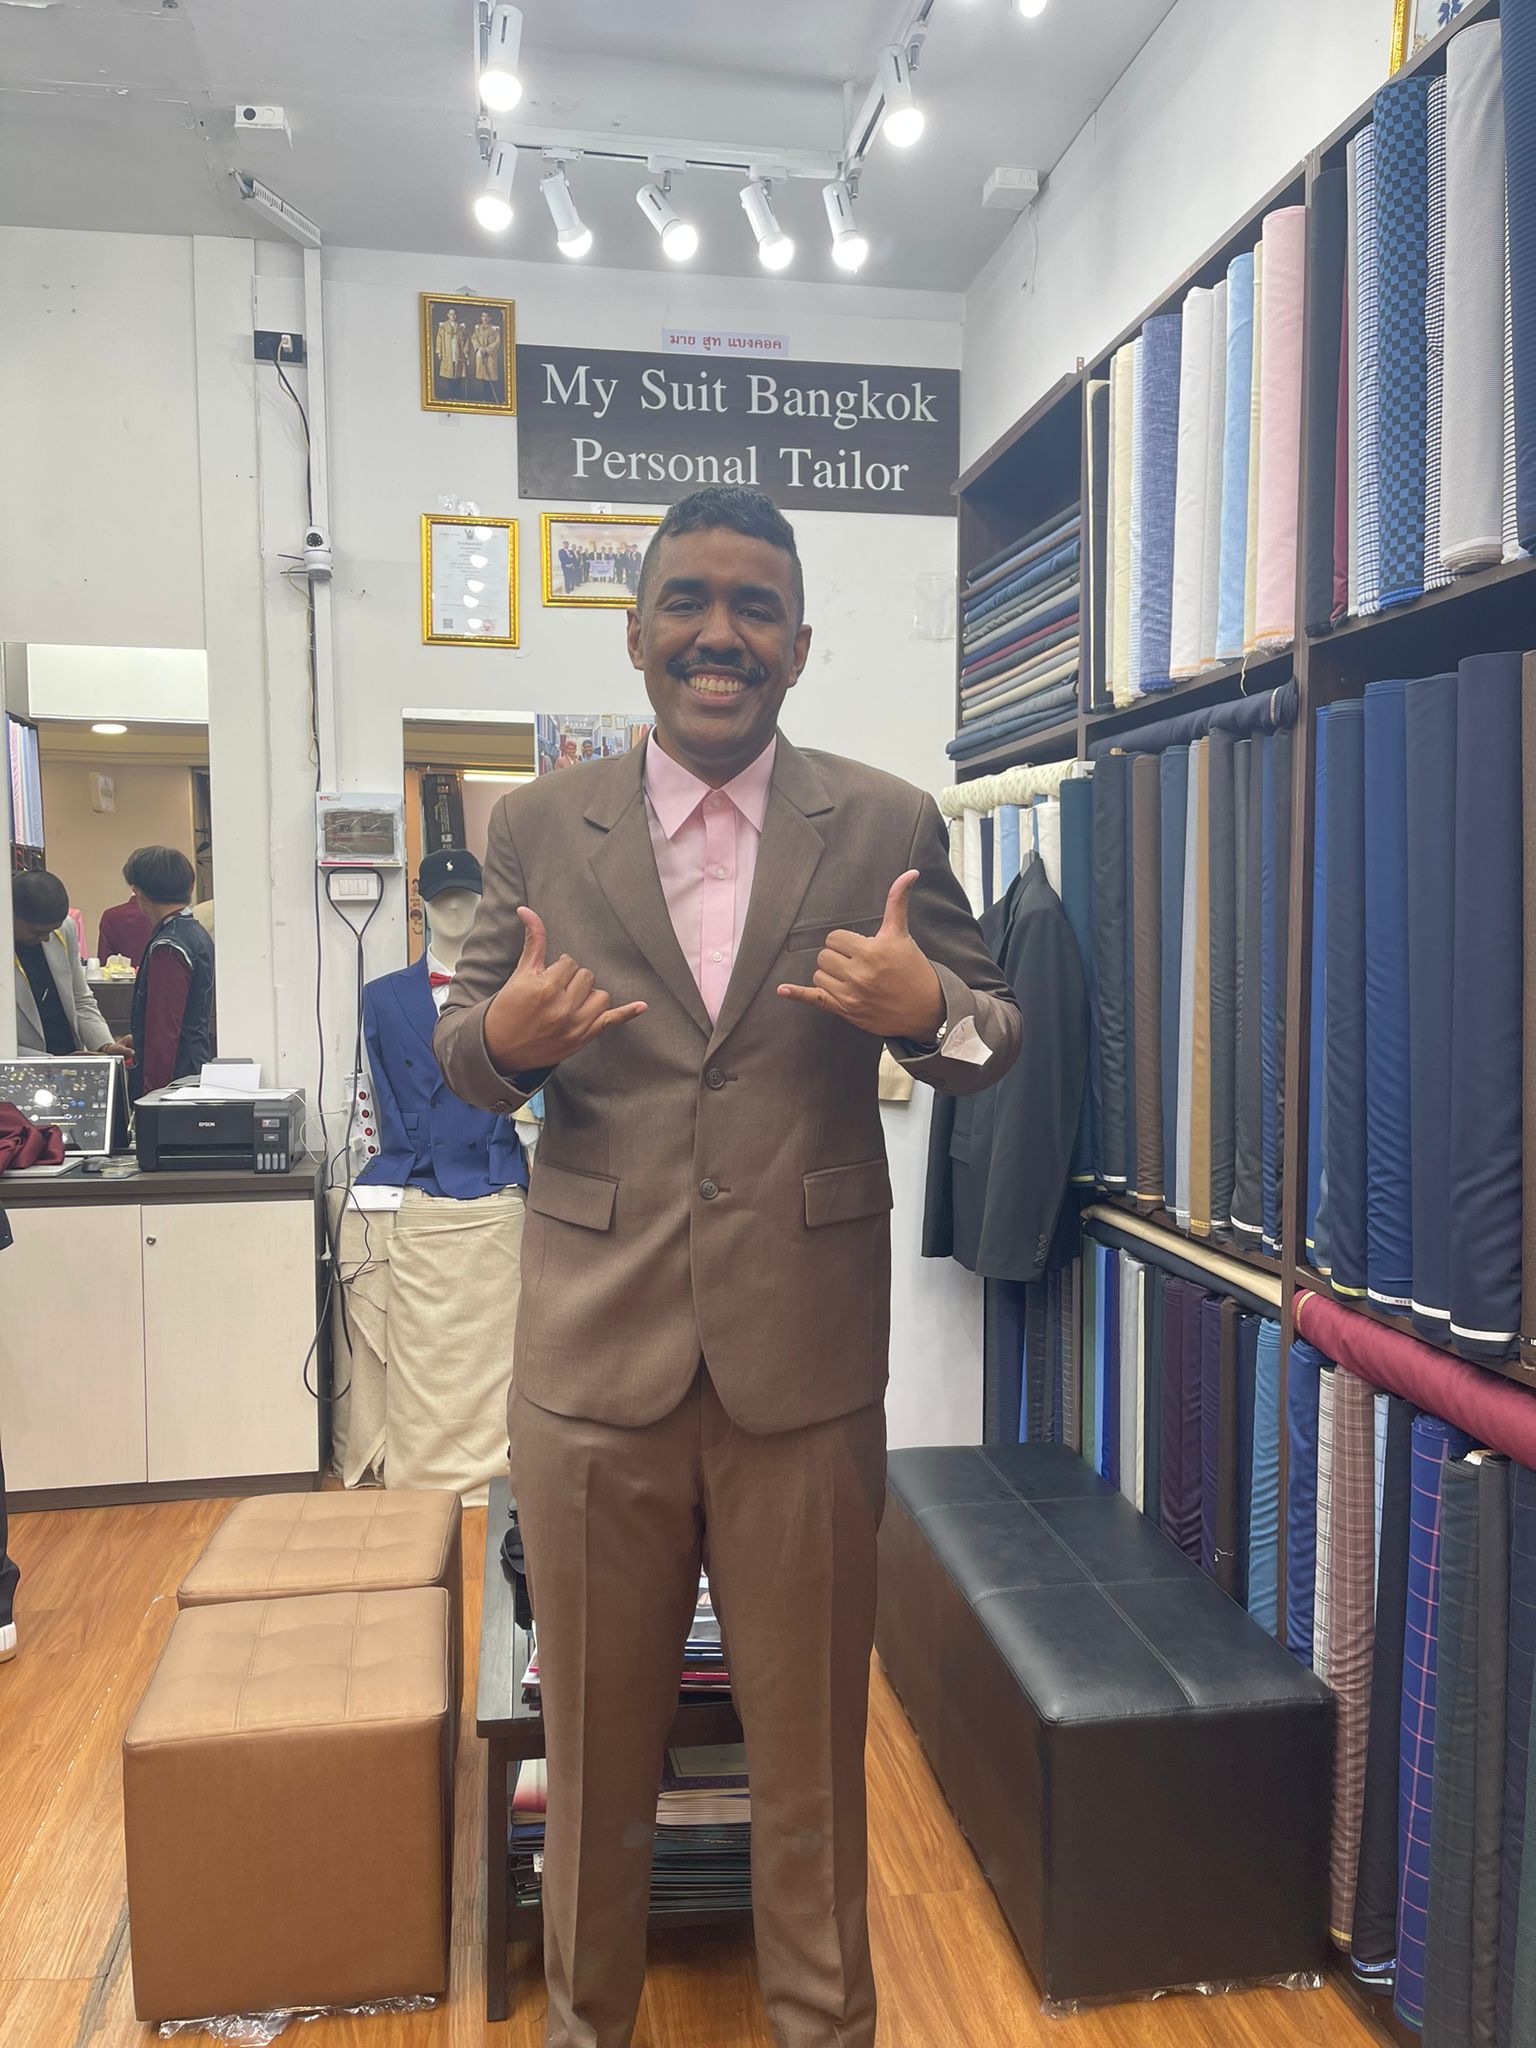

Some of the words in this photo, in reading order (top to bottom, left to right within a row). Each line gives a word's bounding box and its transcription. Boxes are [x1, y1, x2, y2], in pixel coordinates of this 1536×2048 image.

[669, 335, 696, 346] มาย
[702, 335, 722, 352] สูท
[542, 363, 618, 419] My
[641, 368, 728, 414] Suit
[747, 374, 939, 431] Bangkok
[572, 437, 760, 487] Personal
[780, 447, 910, 492] Tailor
